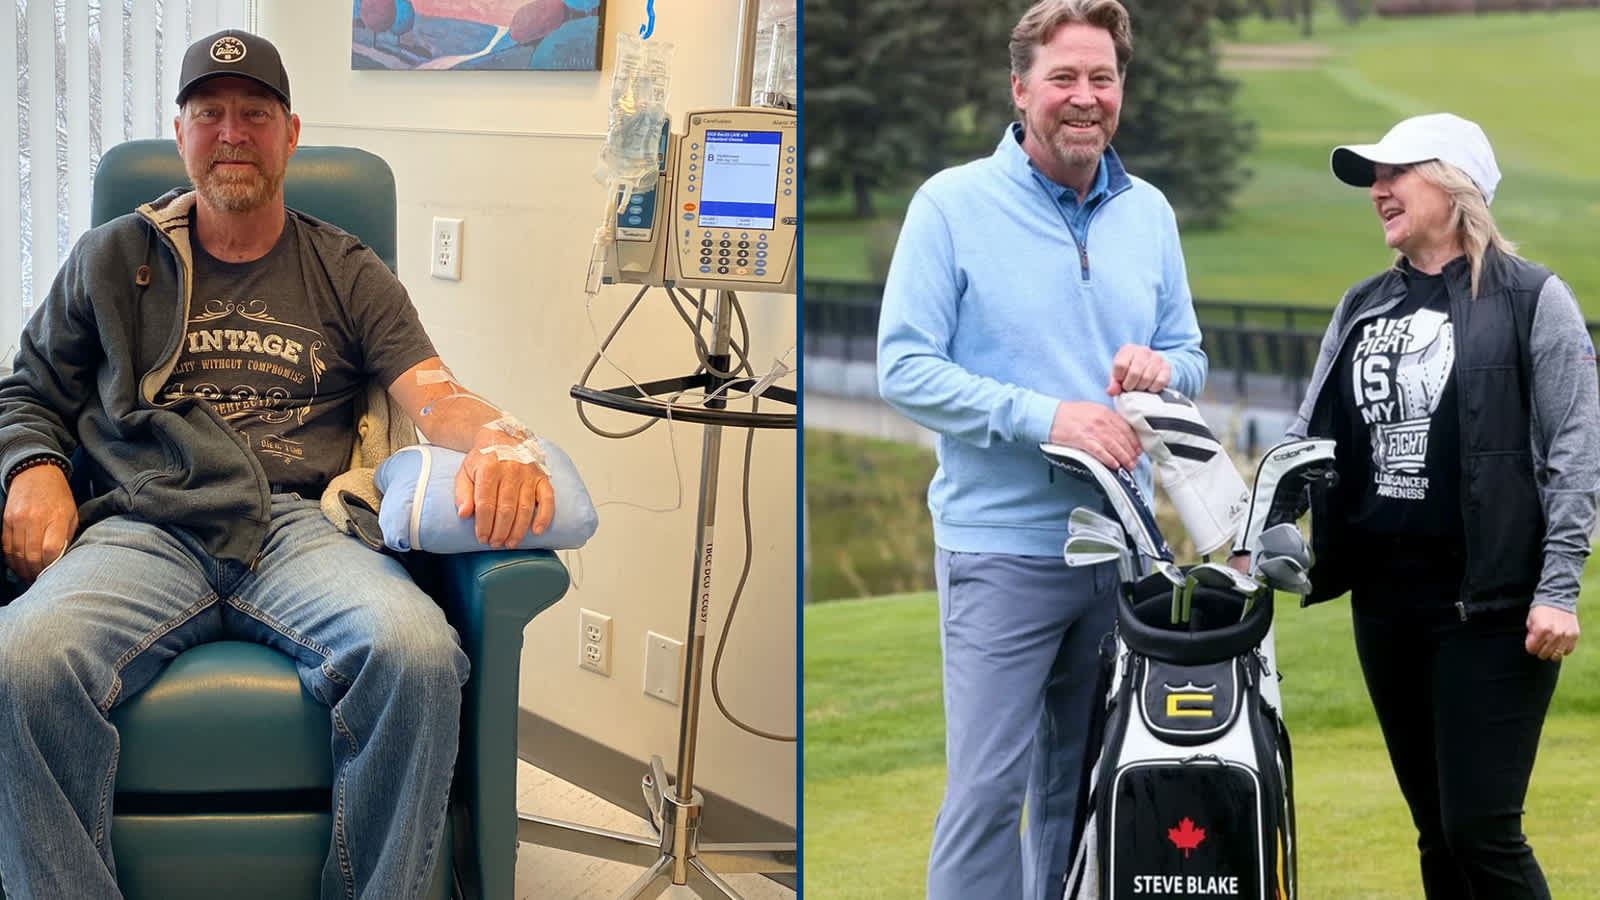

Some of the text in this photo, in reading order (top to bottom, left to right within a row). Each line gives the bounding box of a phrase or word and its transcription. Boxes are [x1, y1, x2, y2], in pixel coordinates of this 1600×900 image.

[1364, 316, 1412, 341] HIS
[187, 330, 303, 365] INTAGE
[1352, 333, 1414, 362] FIGHT
[201, 359, 243, 370] WITHOUT
[248, 360, 306, 384] COMPROMISE
[1353, 355, 1391, 405] IS
[1361, 401, 1395, 424] MY
[1273, 444, 1316, 461] cobra
[1388, 431, 1428, 456] FIGHT
[1133, 876, 1239, 894] STEVE BLAKE
